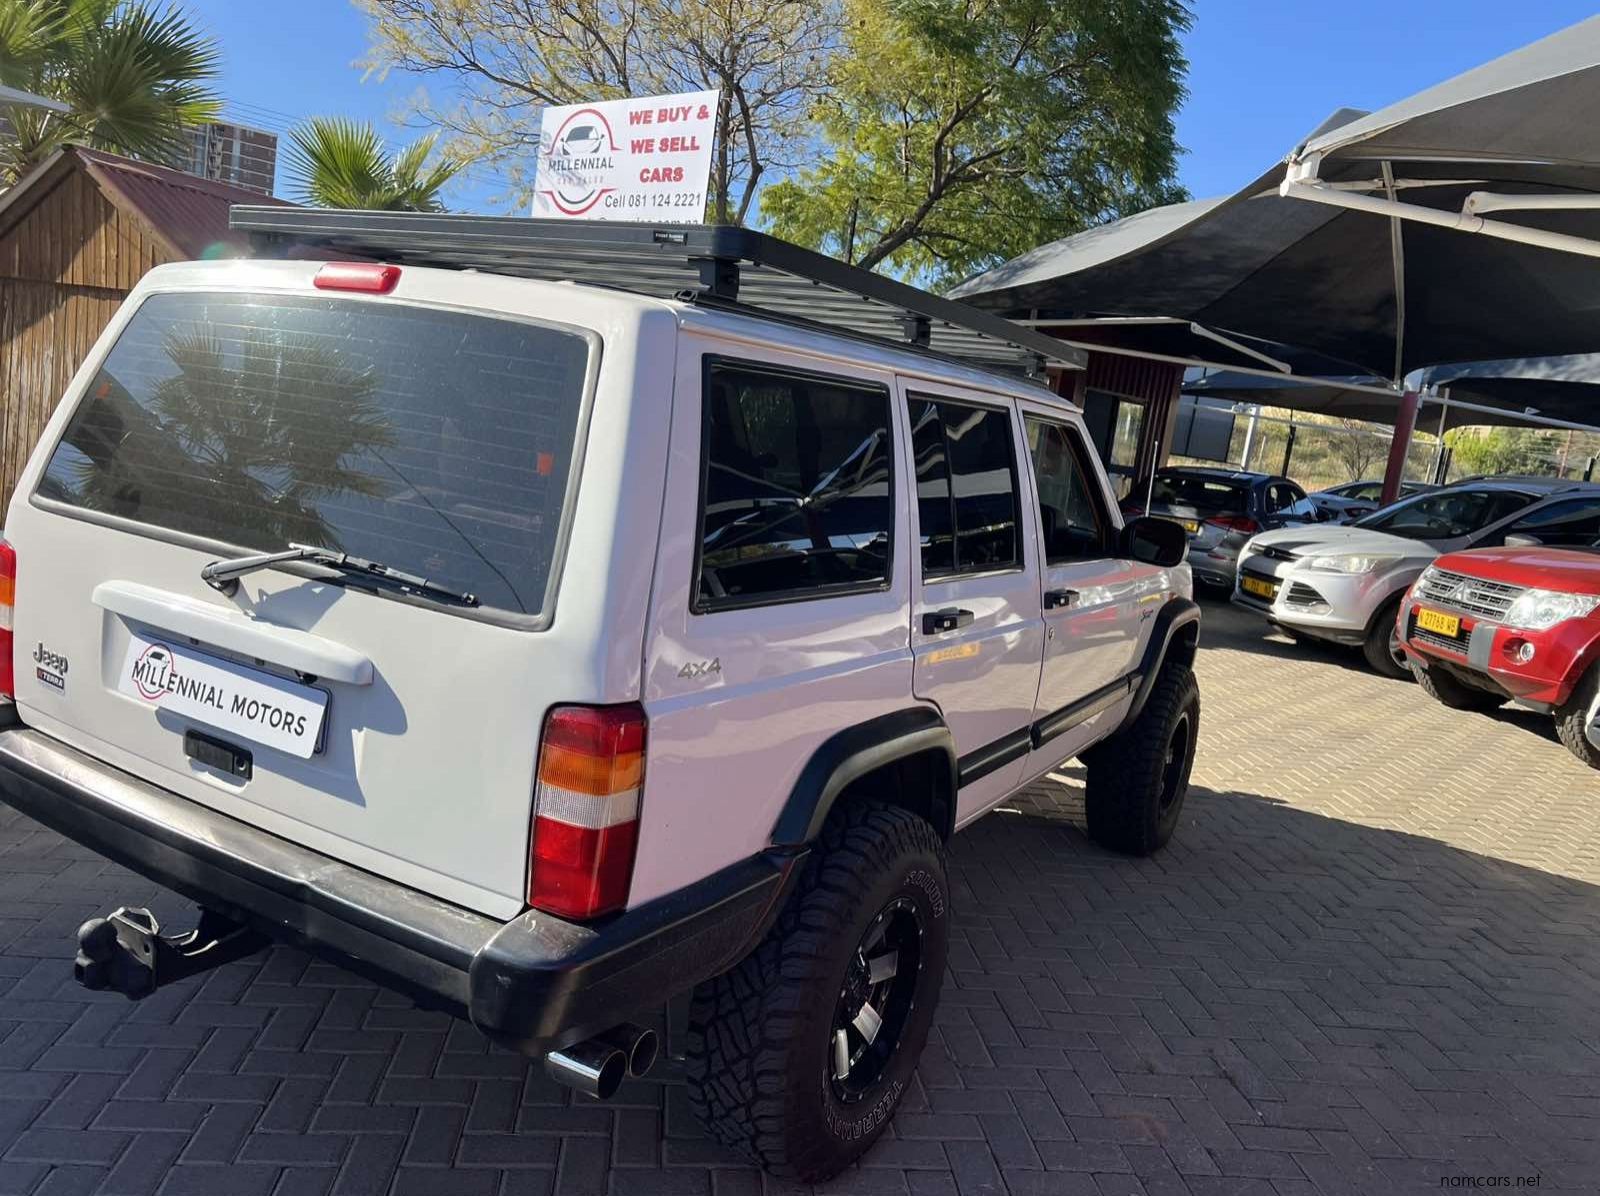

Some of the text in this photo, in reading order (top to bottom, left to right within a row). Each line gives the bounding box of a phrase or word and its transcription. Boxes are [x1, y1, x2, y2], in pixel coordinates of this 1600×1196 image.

[629, 105, 710, 125] WE BUY &
[631, 136, 700, 154] WE SELL
[549, 157, 614, 172] MILLENNIAL
[640, 167, 684, 183] CARS
[605, 193, 701, 208] Cell 081 124 2221
[33, 642, 69, 676] Jeep
[131, 660, 307, 737] MILLENNIAL MOTORS
